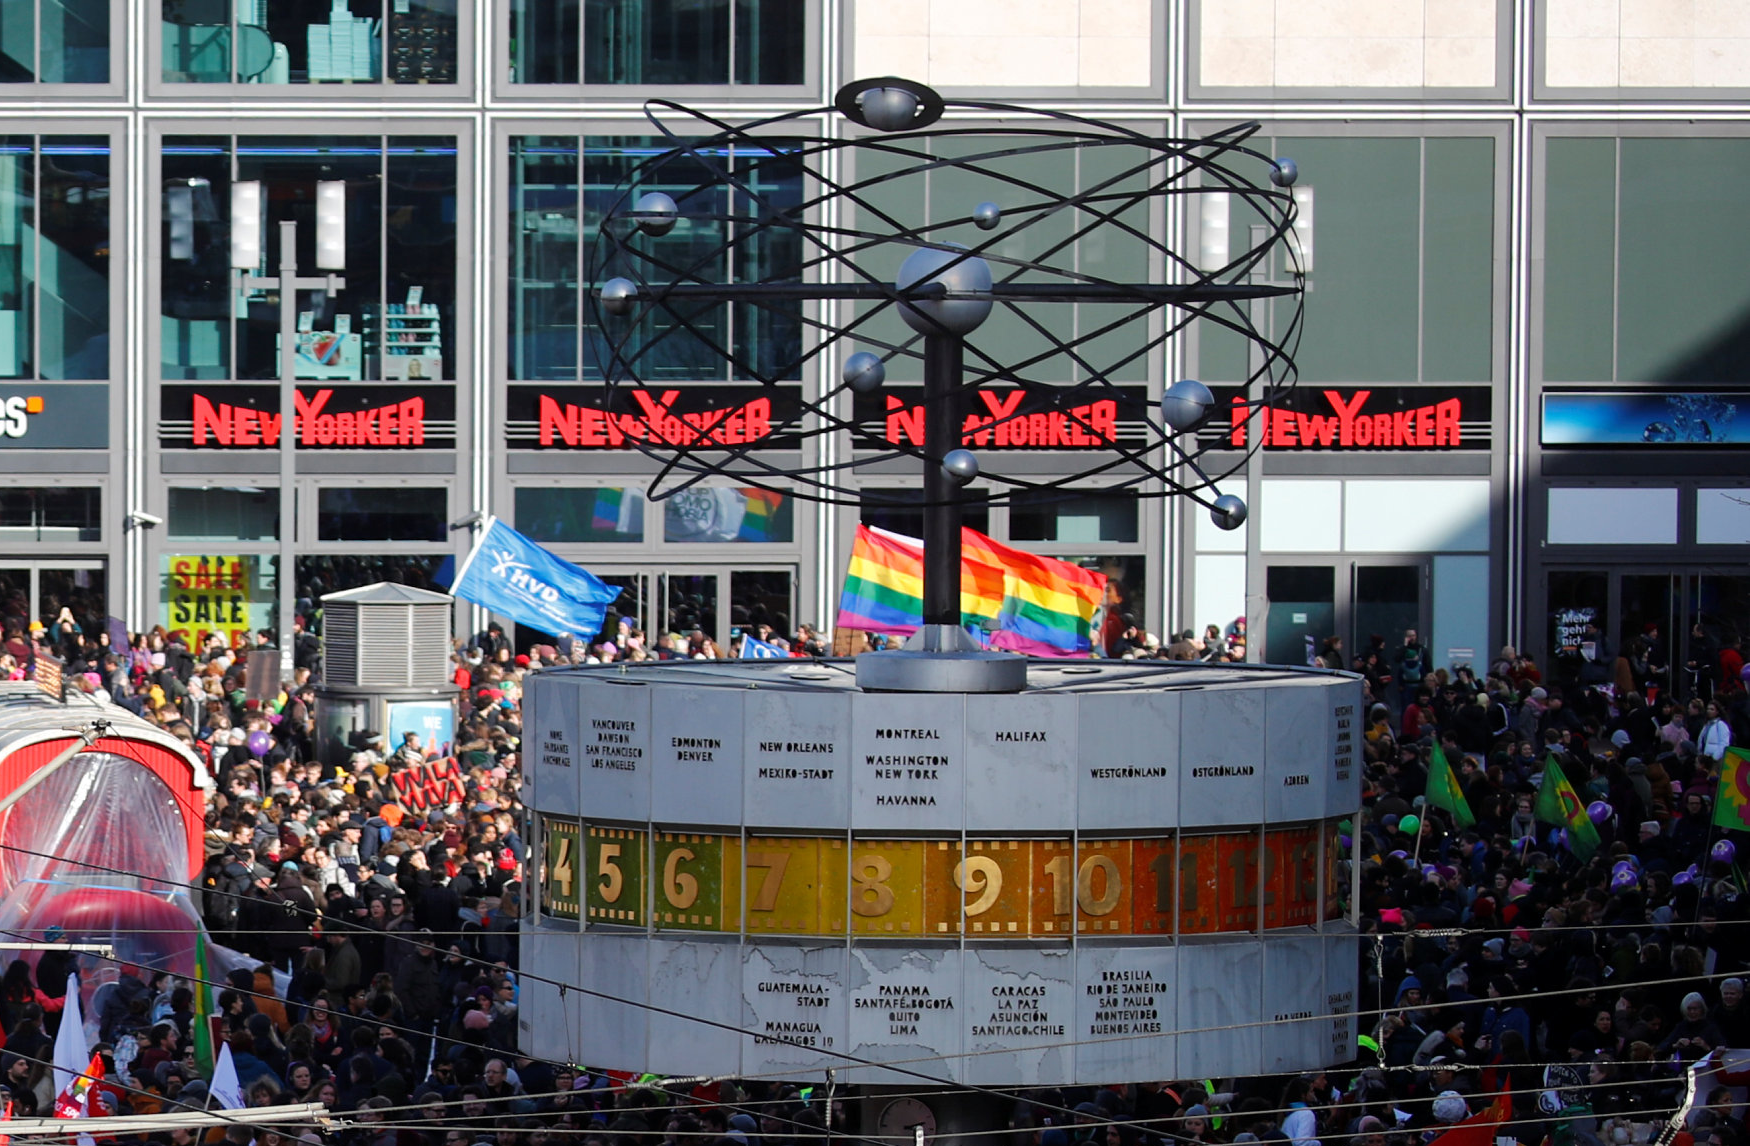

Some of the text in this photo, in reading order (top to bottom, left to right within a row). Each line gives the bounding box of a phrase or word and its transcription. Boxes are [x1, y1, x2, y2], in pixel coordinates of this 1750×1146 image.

[175, 560, 243, 589] SALE
[510, 569, 559, 602] HVD
[175, 594, 243, 623] SALE
[1562, 613, 1590, 624] Mehr
[423, 716, 442, 729] WE
[592, 719, 635, 731] VANCOUVER
[598, 732, 629, 744] DAWSON
[876, 729, 940, 740] MONTREAL
[996, 731, 1046, 742] HALIFAX
[672, 737, 721, 749] EDMONTON
[760, 742, 834, 753] NEW ORLEANS
[586, 744, 642, 758] SAN FRANCISCO
[677, 751, 713, 762] DENVER
[591, 758, 635, 771] LOS ANGELES
[866, 755, 949, 766] WASHINGTON
[759, 768, 834, 779] MEXIKO-STADT
[875, 769, 938, 780] NEW YORK
[1091, 764, 1167, 779] WESTGRÖNLAND
[1193, 764, 1254, 777] OSTGRÖNLAND
[1284, 775, 1309, 787] AZOREN
[877, 796, 937, 806] HAVANNA
[553, 838, 572, 897] 4
[598, 843, 623, 903] 5
[663, 847, 699, 910] 6
[746, 852, 793, 912] 7
[850, 855, 894, 917] 8
[953, 855, 1003, 917] 9
[1044, 854, 1122, 916] 10
[1149, 852, 1198, 912] 11
[1228, 845, 1276, 907] 12
[1102, 970, 1153, 982] BRASILIA
[879, 985, 930, 996] PANAMA
[992, 986, 1046, 997] CARACAS
[1086, 983, 1167, 995] RIO DE JANEIRO
[797, 997, 830, 1007] STADT
[998, 999, 1038, 1010] LA PAZ
[1099, 996, 1154, 1008] SÃO PAULO
[889, 1012, 920, 1023] QUITO
[990, 1010, 1048, 1022] ASUNCIÓN
[1095, 1009, 1157, 1021] MONTEVIDEO
[766, 1022, 821, 1033] MANAGUA
[890, 1025, 918, 1035] LIMA
[1091, 1022, 1161, 1035] BUENOS AIRES
